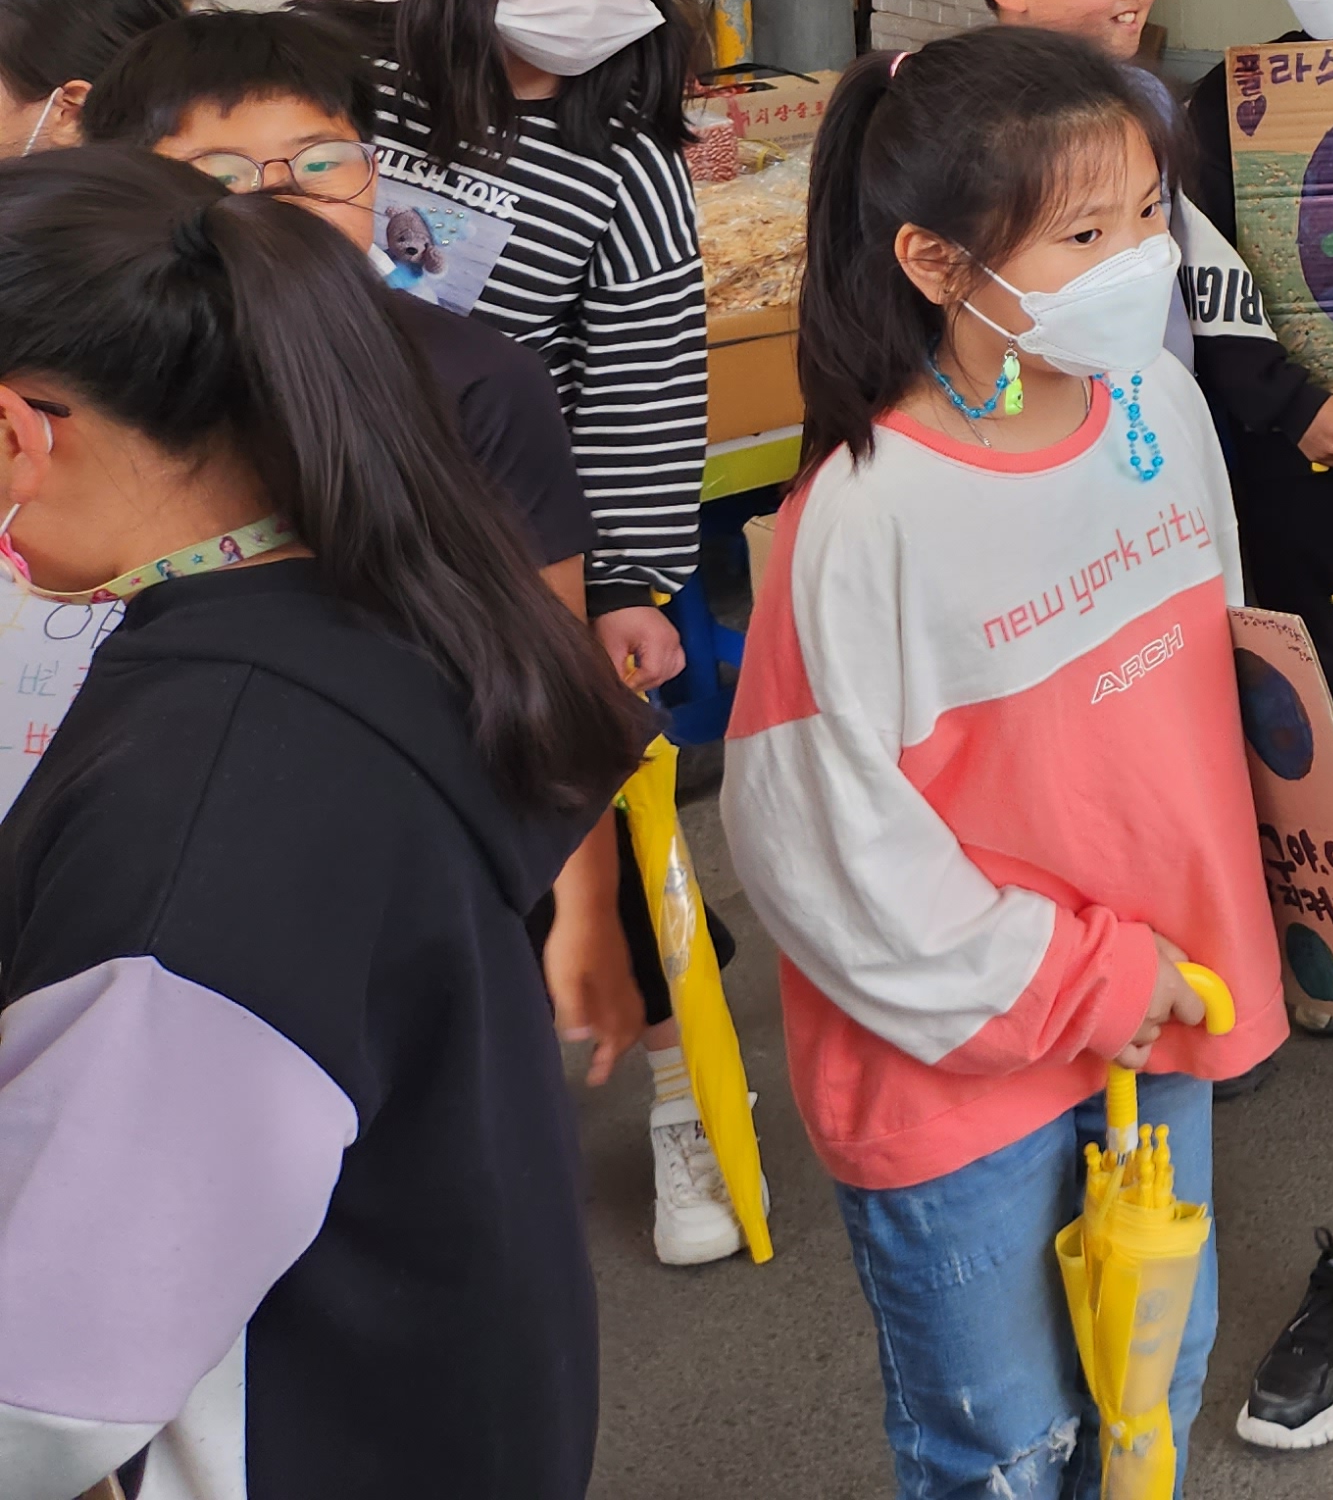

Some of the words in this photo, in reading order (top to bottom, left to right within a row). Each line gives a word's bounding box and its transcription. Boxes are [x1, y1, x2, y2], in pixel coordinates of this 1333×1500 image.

[452, 173, 521, 220] TOYS
[982, 584, 1064, 650] new
[1068, 530, 1142, 616] york
[1146, 503, 1213, 565] city
[1090, 624, 1186, 704] ARCH
